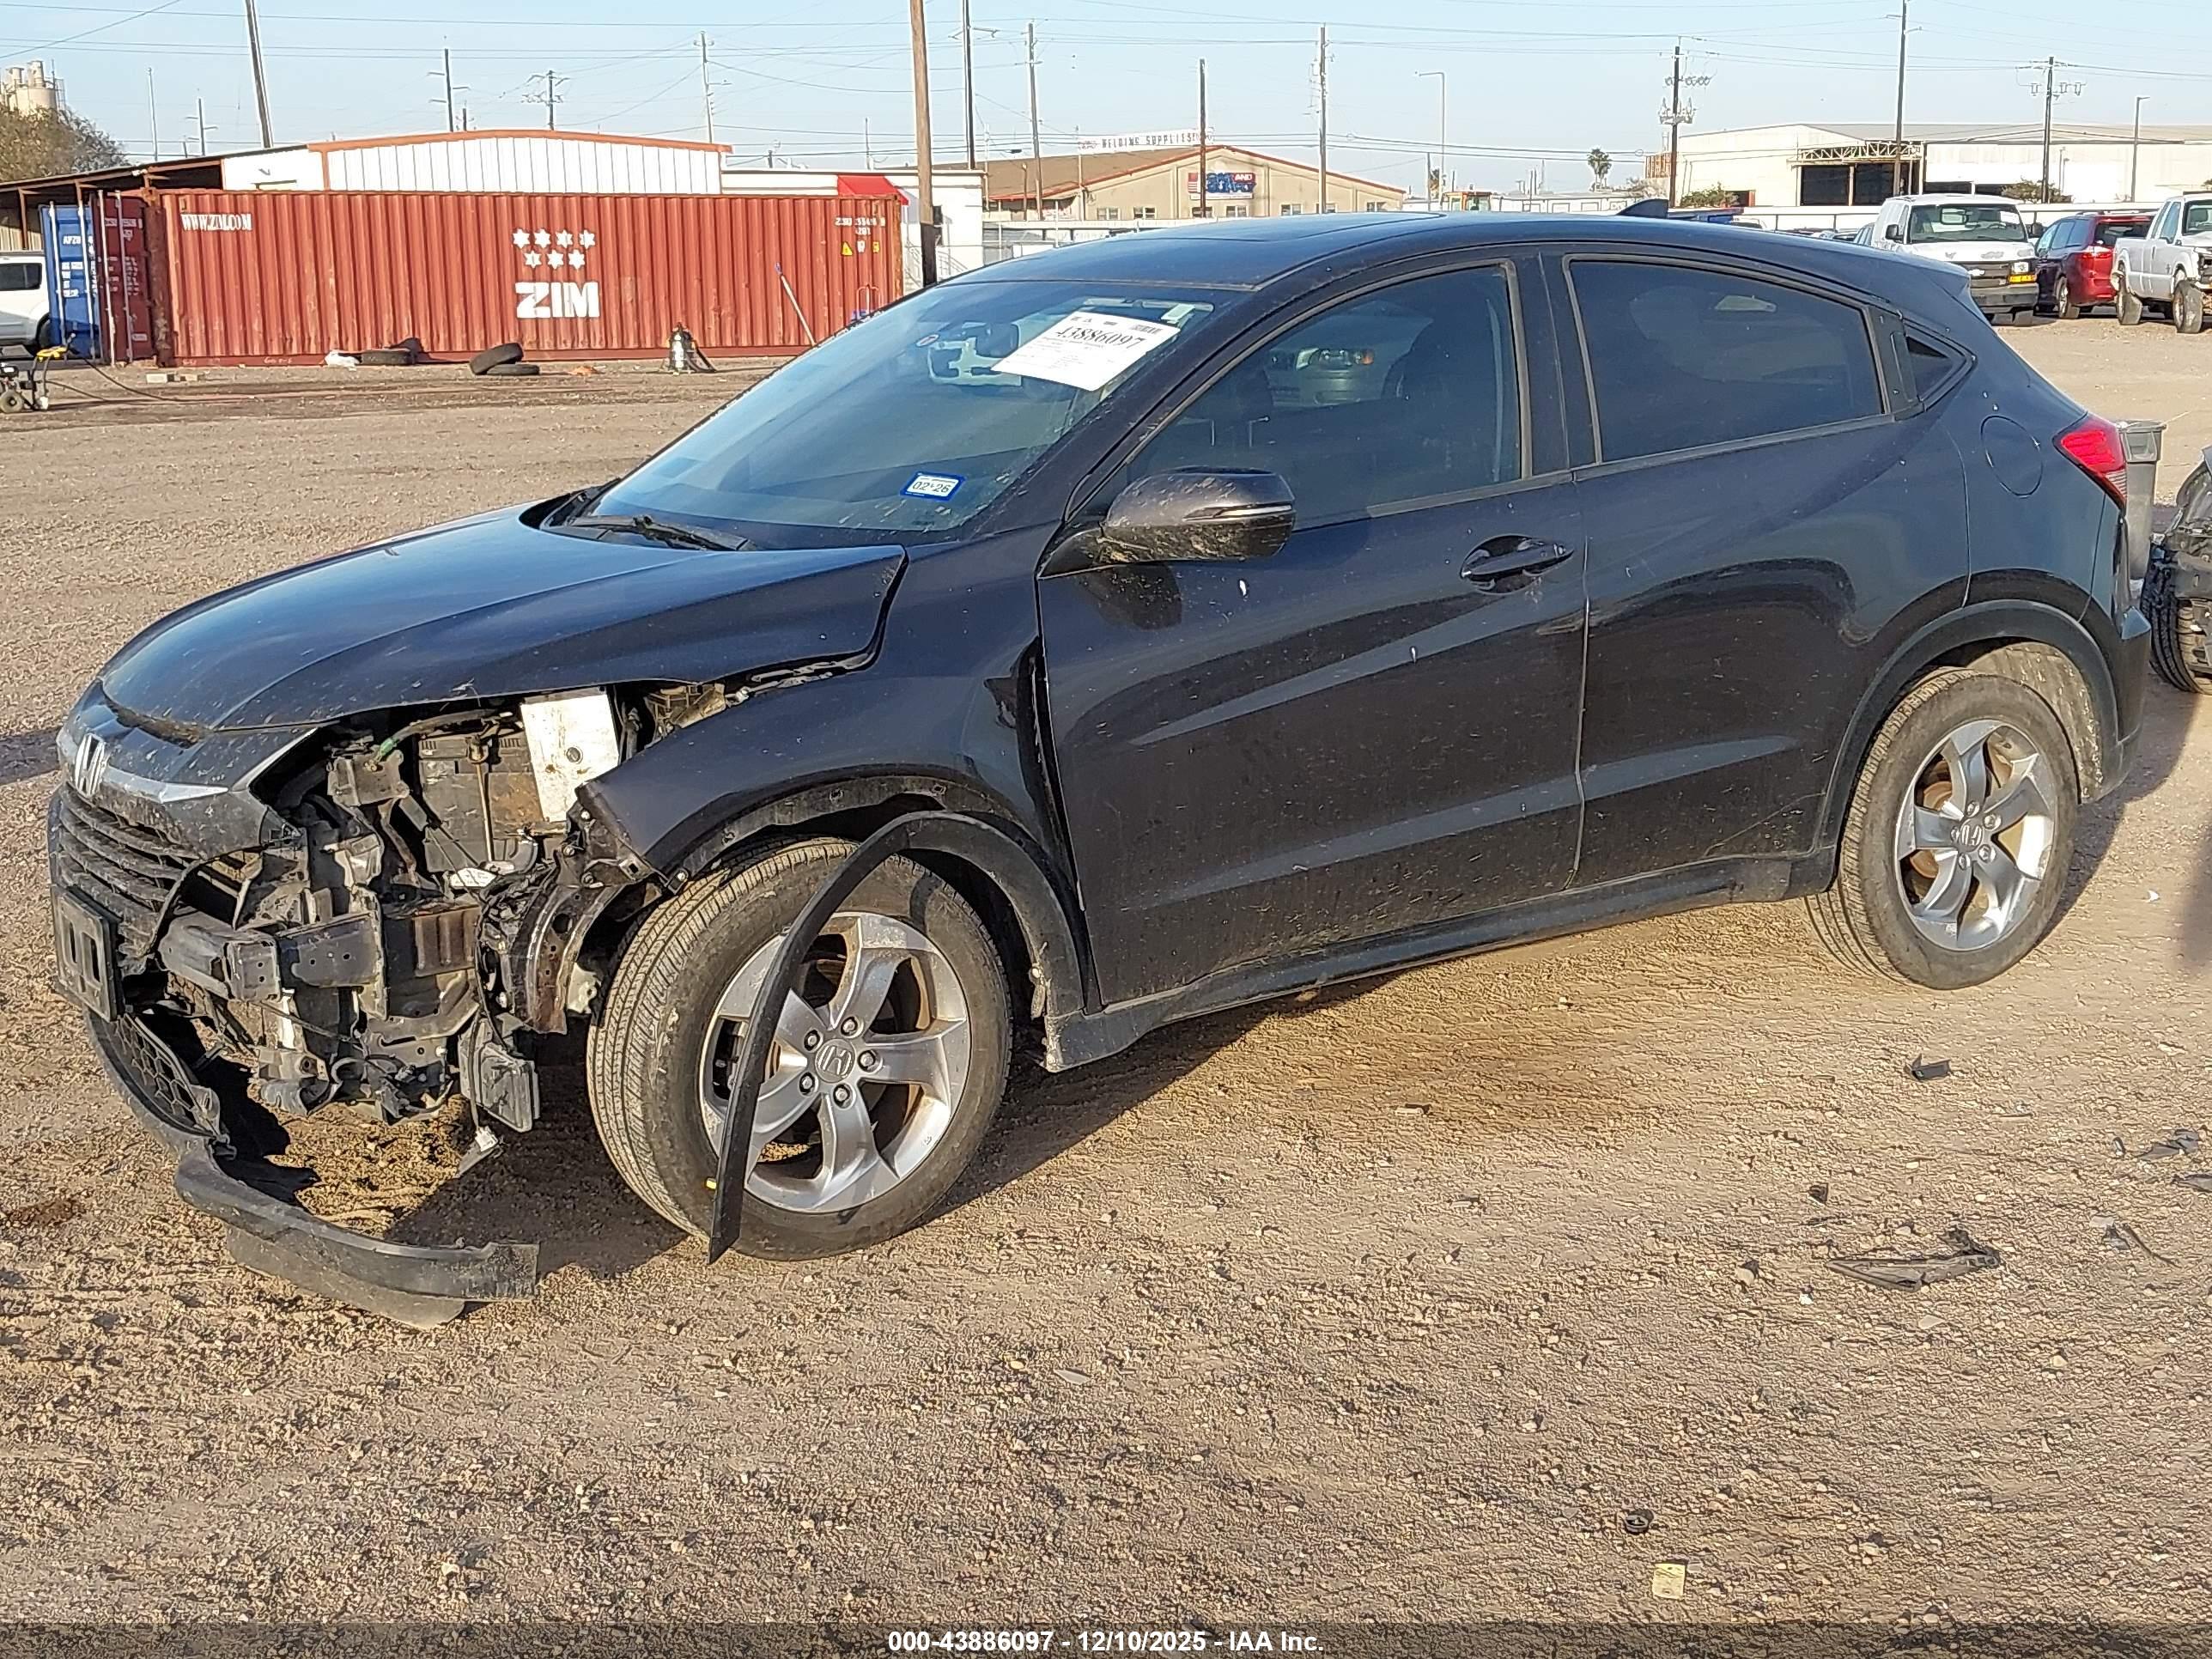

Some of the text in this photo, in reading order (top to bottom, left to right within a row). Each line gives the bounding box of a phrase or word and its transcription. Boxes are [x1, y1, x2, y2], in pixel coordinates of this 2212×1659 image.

[1102, 137, 1139, 148] WELDING
[1146, 132, 1192, 145] SUPPLIES
[514, 282, 600, 318] ZIM
[1055, 325, 1146, 349] 43886097
